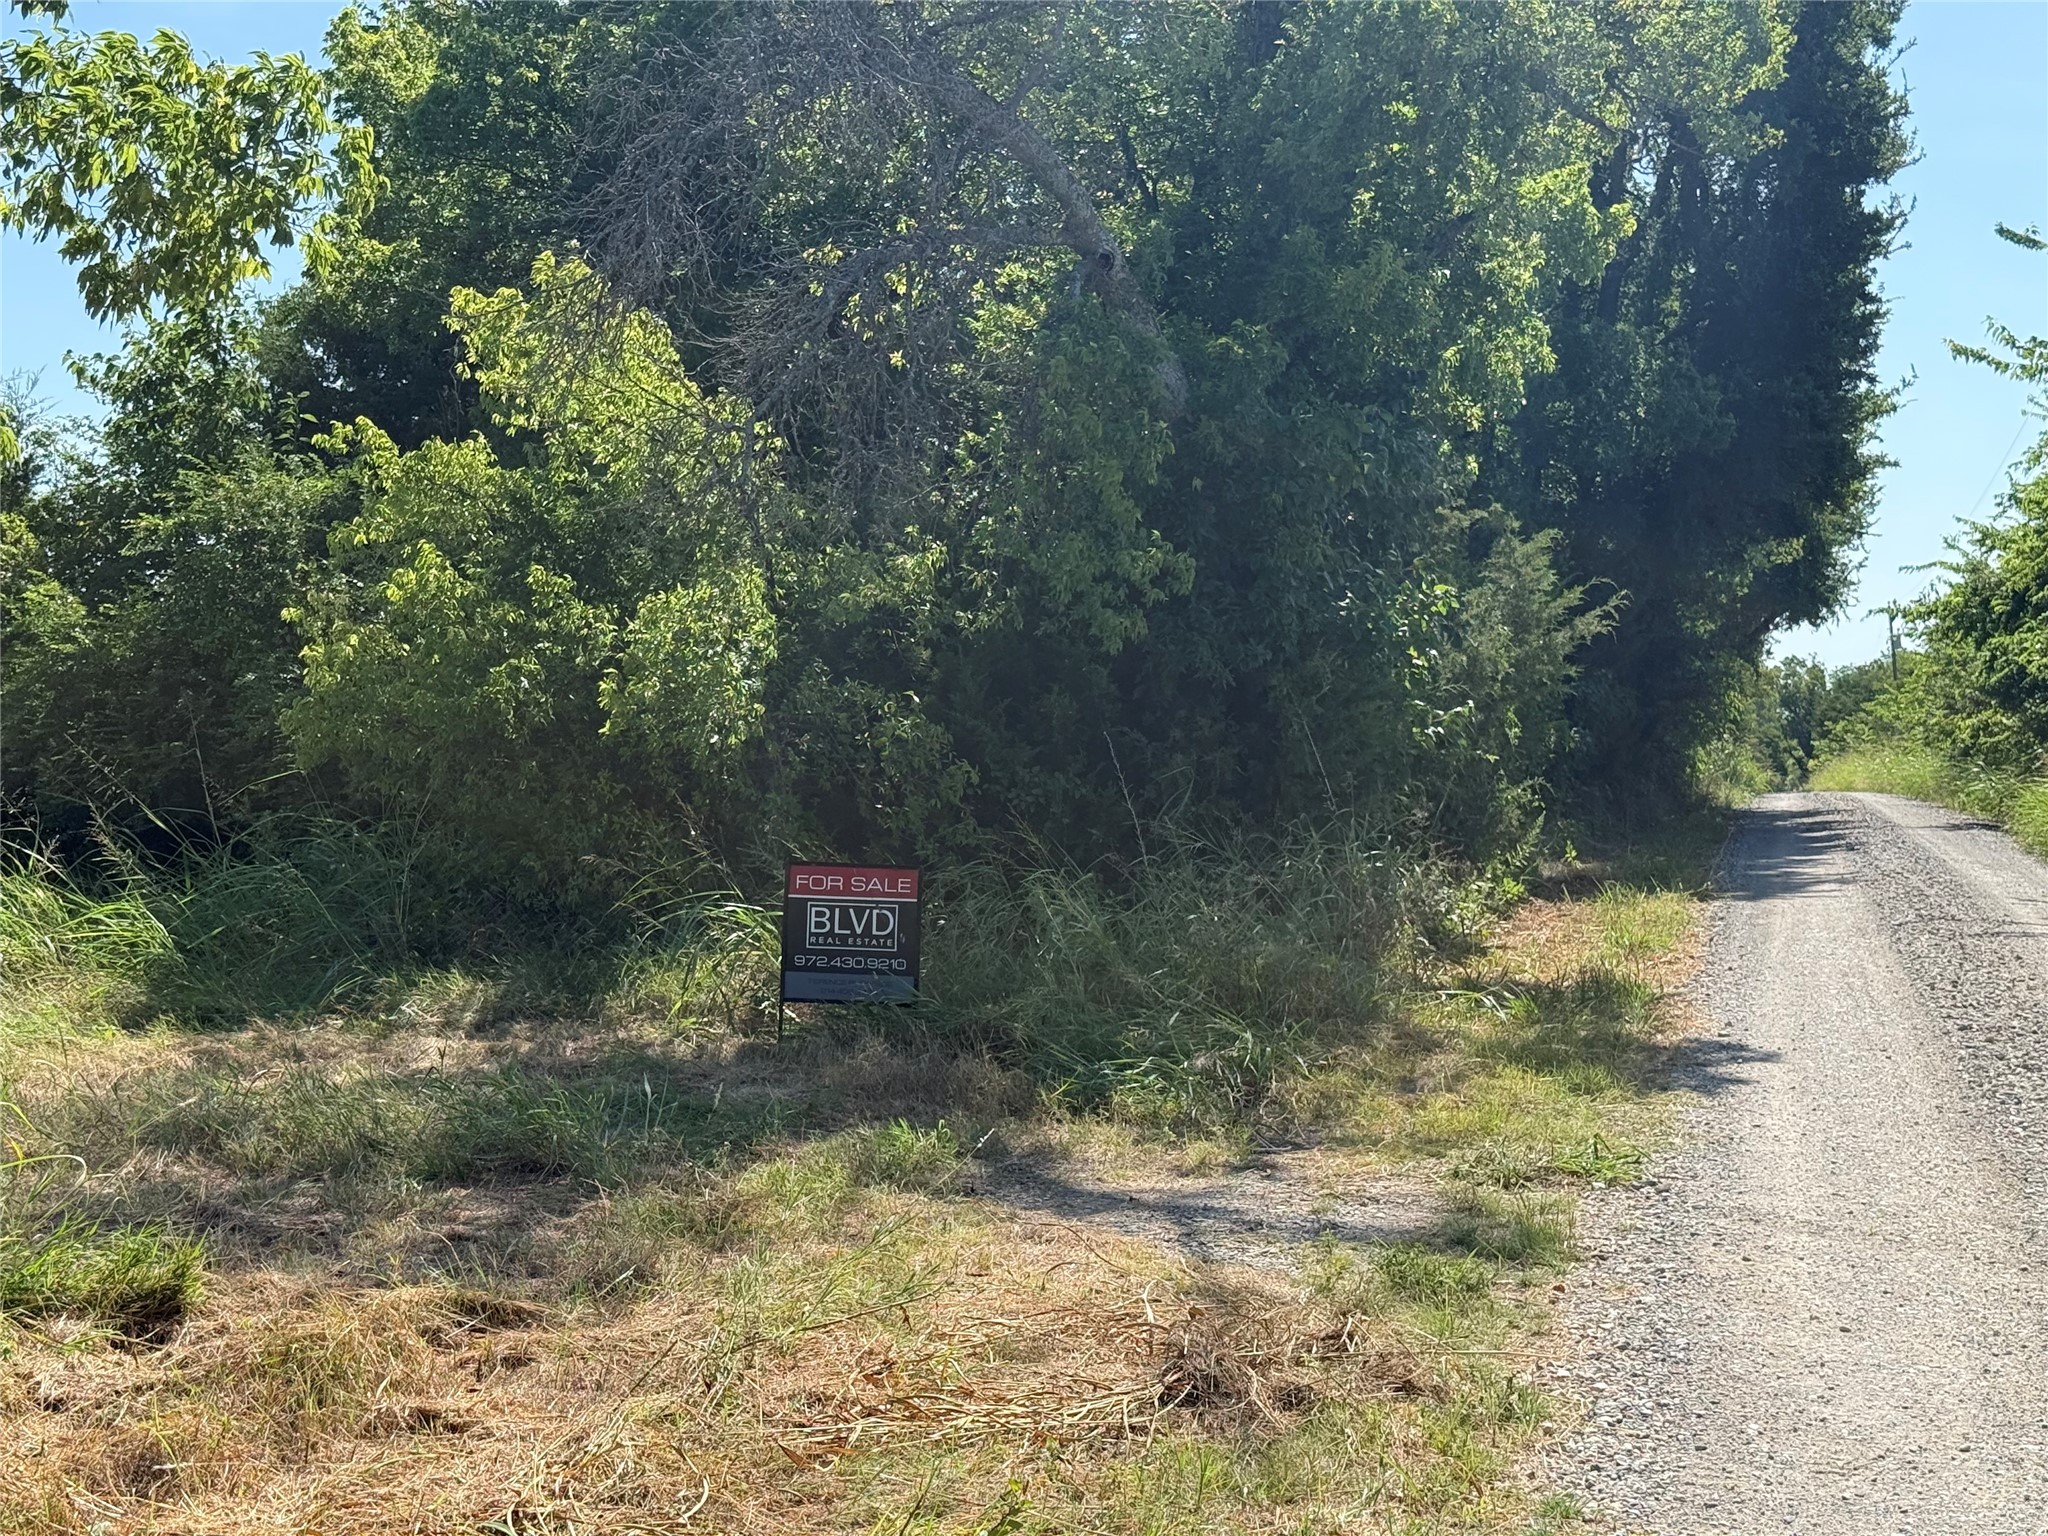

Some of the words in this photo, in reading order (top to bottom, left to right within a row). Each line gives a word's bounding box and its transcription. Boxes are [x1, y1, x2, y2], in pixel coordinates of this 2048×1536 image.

[796, 875, 843, 891] FOR
[851, 876, 911, 893] SALE
[810, 907, 895, 936] BLVD
[810, 936, 841, 945] REAL
[848, 938, 894, 947] ESTATE
[794, 955, 907, 970] 972.430.9210
